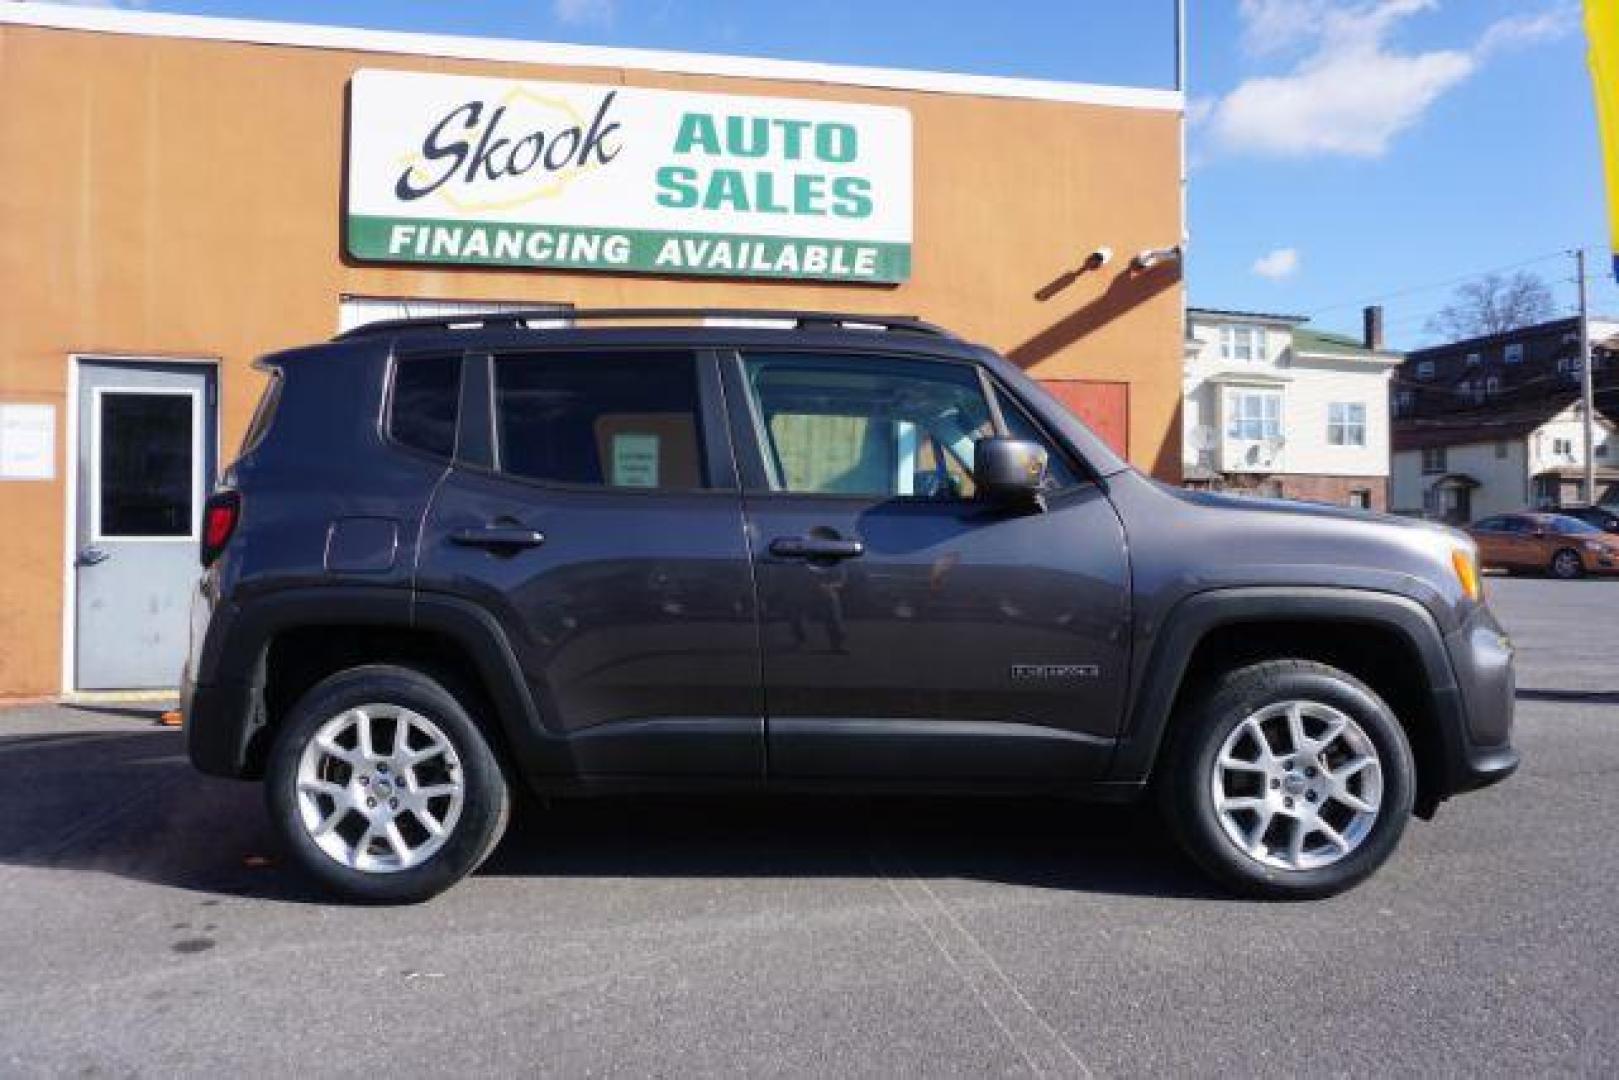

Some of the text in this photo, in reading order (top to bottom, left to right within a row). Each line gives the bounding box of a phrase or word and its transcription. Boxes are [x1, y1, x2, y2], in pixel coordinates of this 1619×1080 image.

[395, 90, 624, 201] Skook
[673, 112, 859, 163] AUTO
[655, 166, 874, 218] SALES
[388, 224, 879, 276] FINANCING AVAILABLE
